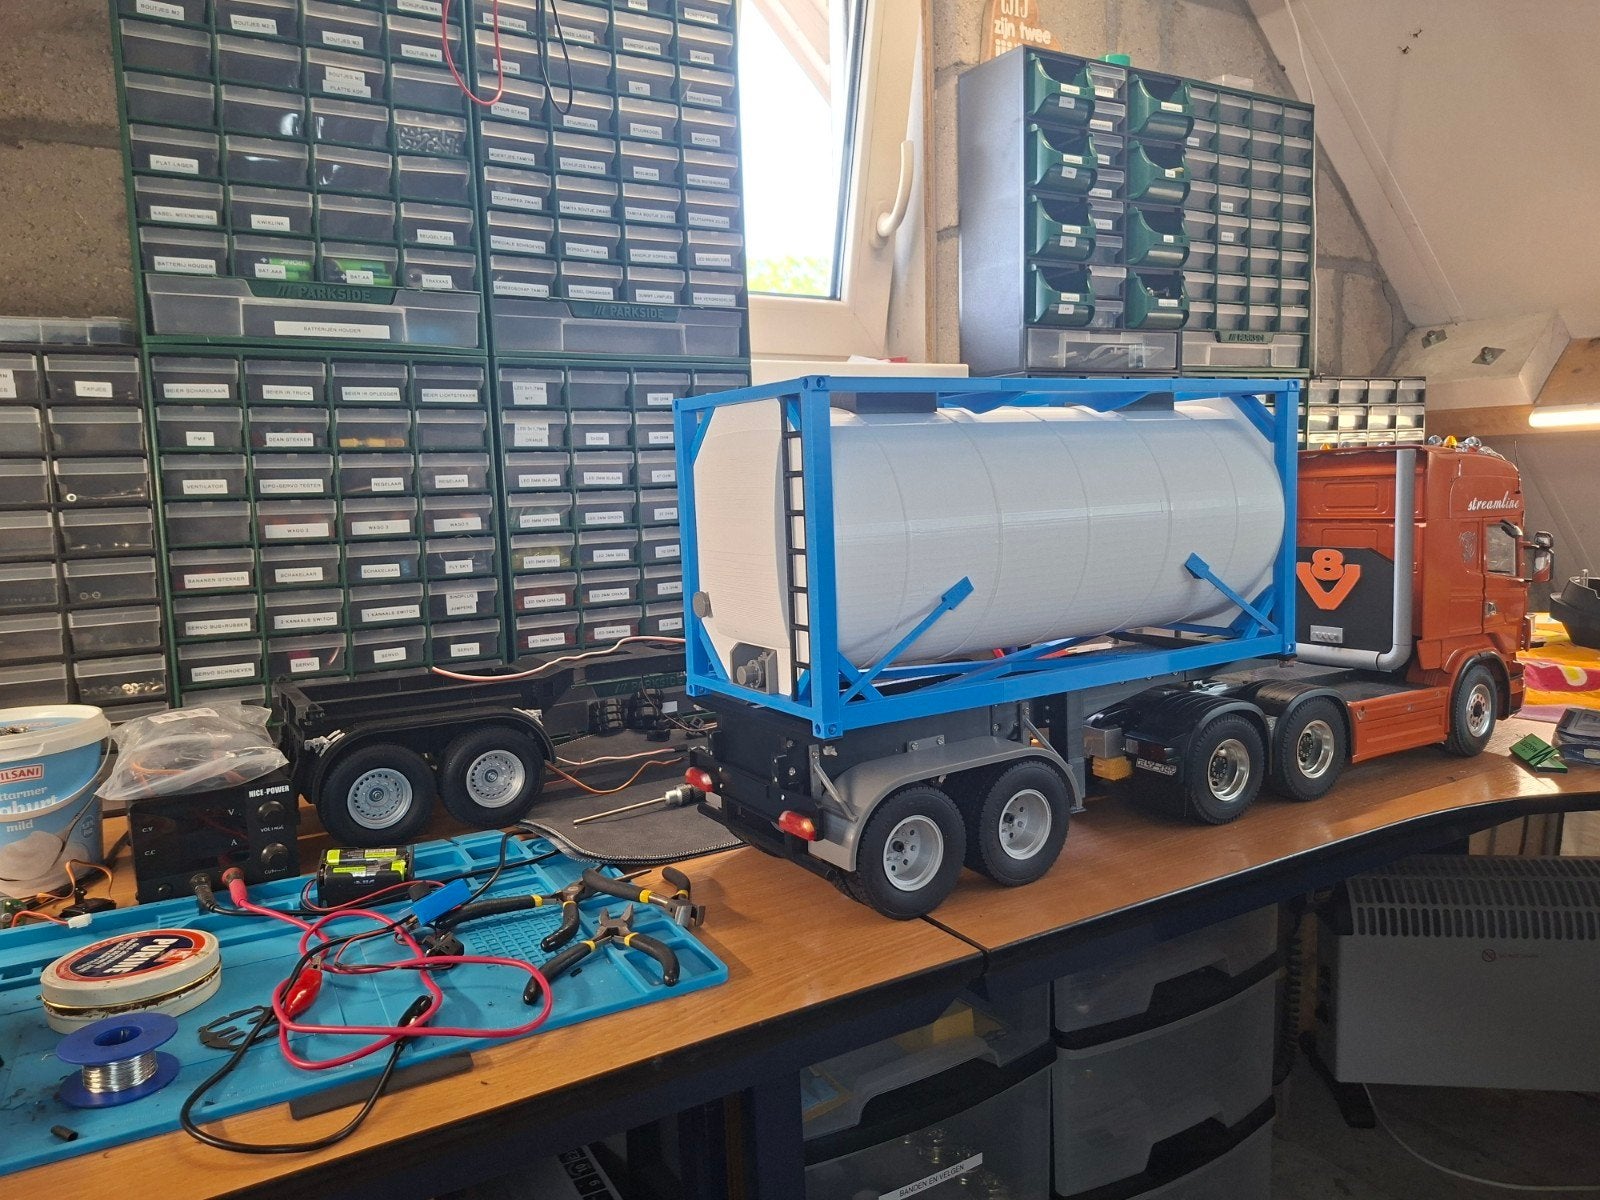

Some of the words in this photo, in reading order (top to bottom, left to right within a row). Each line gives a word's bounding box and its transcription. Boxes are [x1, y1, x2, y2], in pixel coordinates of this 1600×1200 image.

[994, 16, 1016, 40] zijn
[1019, 21, 1052, 45] twee
[298, 287, 372, 300] PARKSIDE
[609, 305, 665, 320] PARKSIDE
[1467, 490, 1520, 511] streamline
[249, 784, 290, 798] NICE-POWER
[6, 819, 33, 832] mild
[230, 838, 238, 846] A
[899, 1179, 927, 1197] BANDEN
[928, 1175, 938, 1185] EN
[939, 1164, 965, 1181] VELGEN
